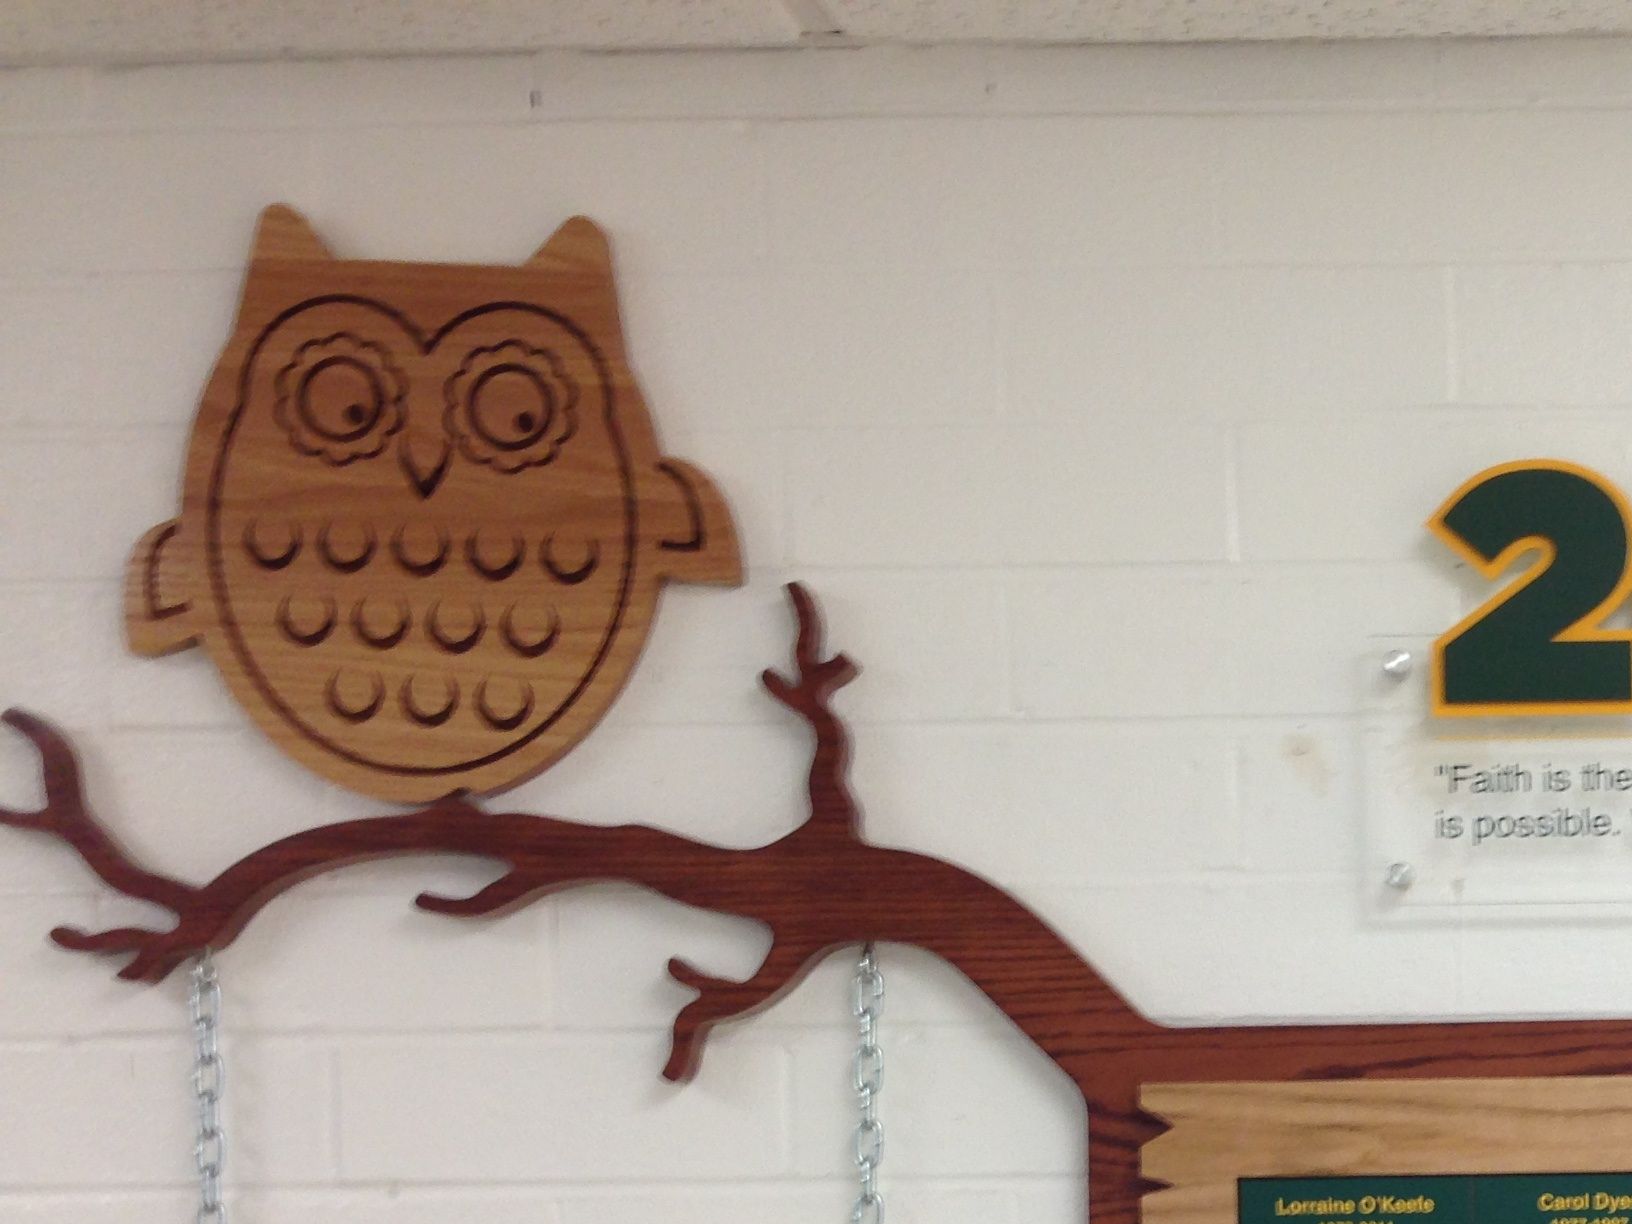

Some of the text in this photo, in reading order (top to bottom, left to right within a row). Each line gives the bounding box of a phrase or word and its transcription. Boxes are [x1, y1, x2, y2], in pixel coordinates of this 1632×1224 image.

[1541, 762, 1574, 792] is
[1434, 806, 1464, 840] is
[1470, 804, 1622, 846] possible.
[1275, 1198, 1356, 1216] Lorraine
[1537, 1193, 1590, 1212] Carol
